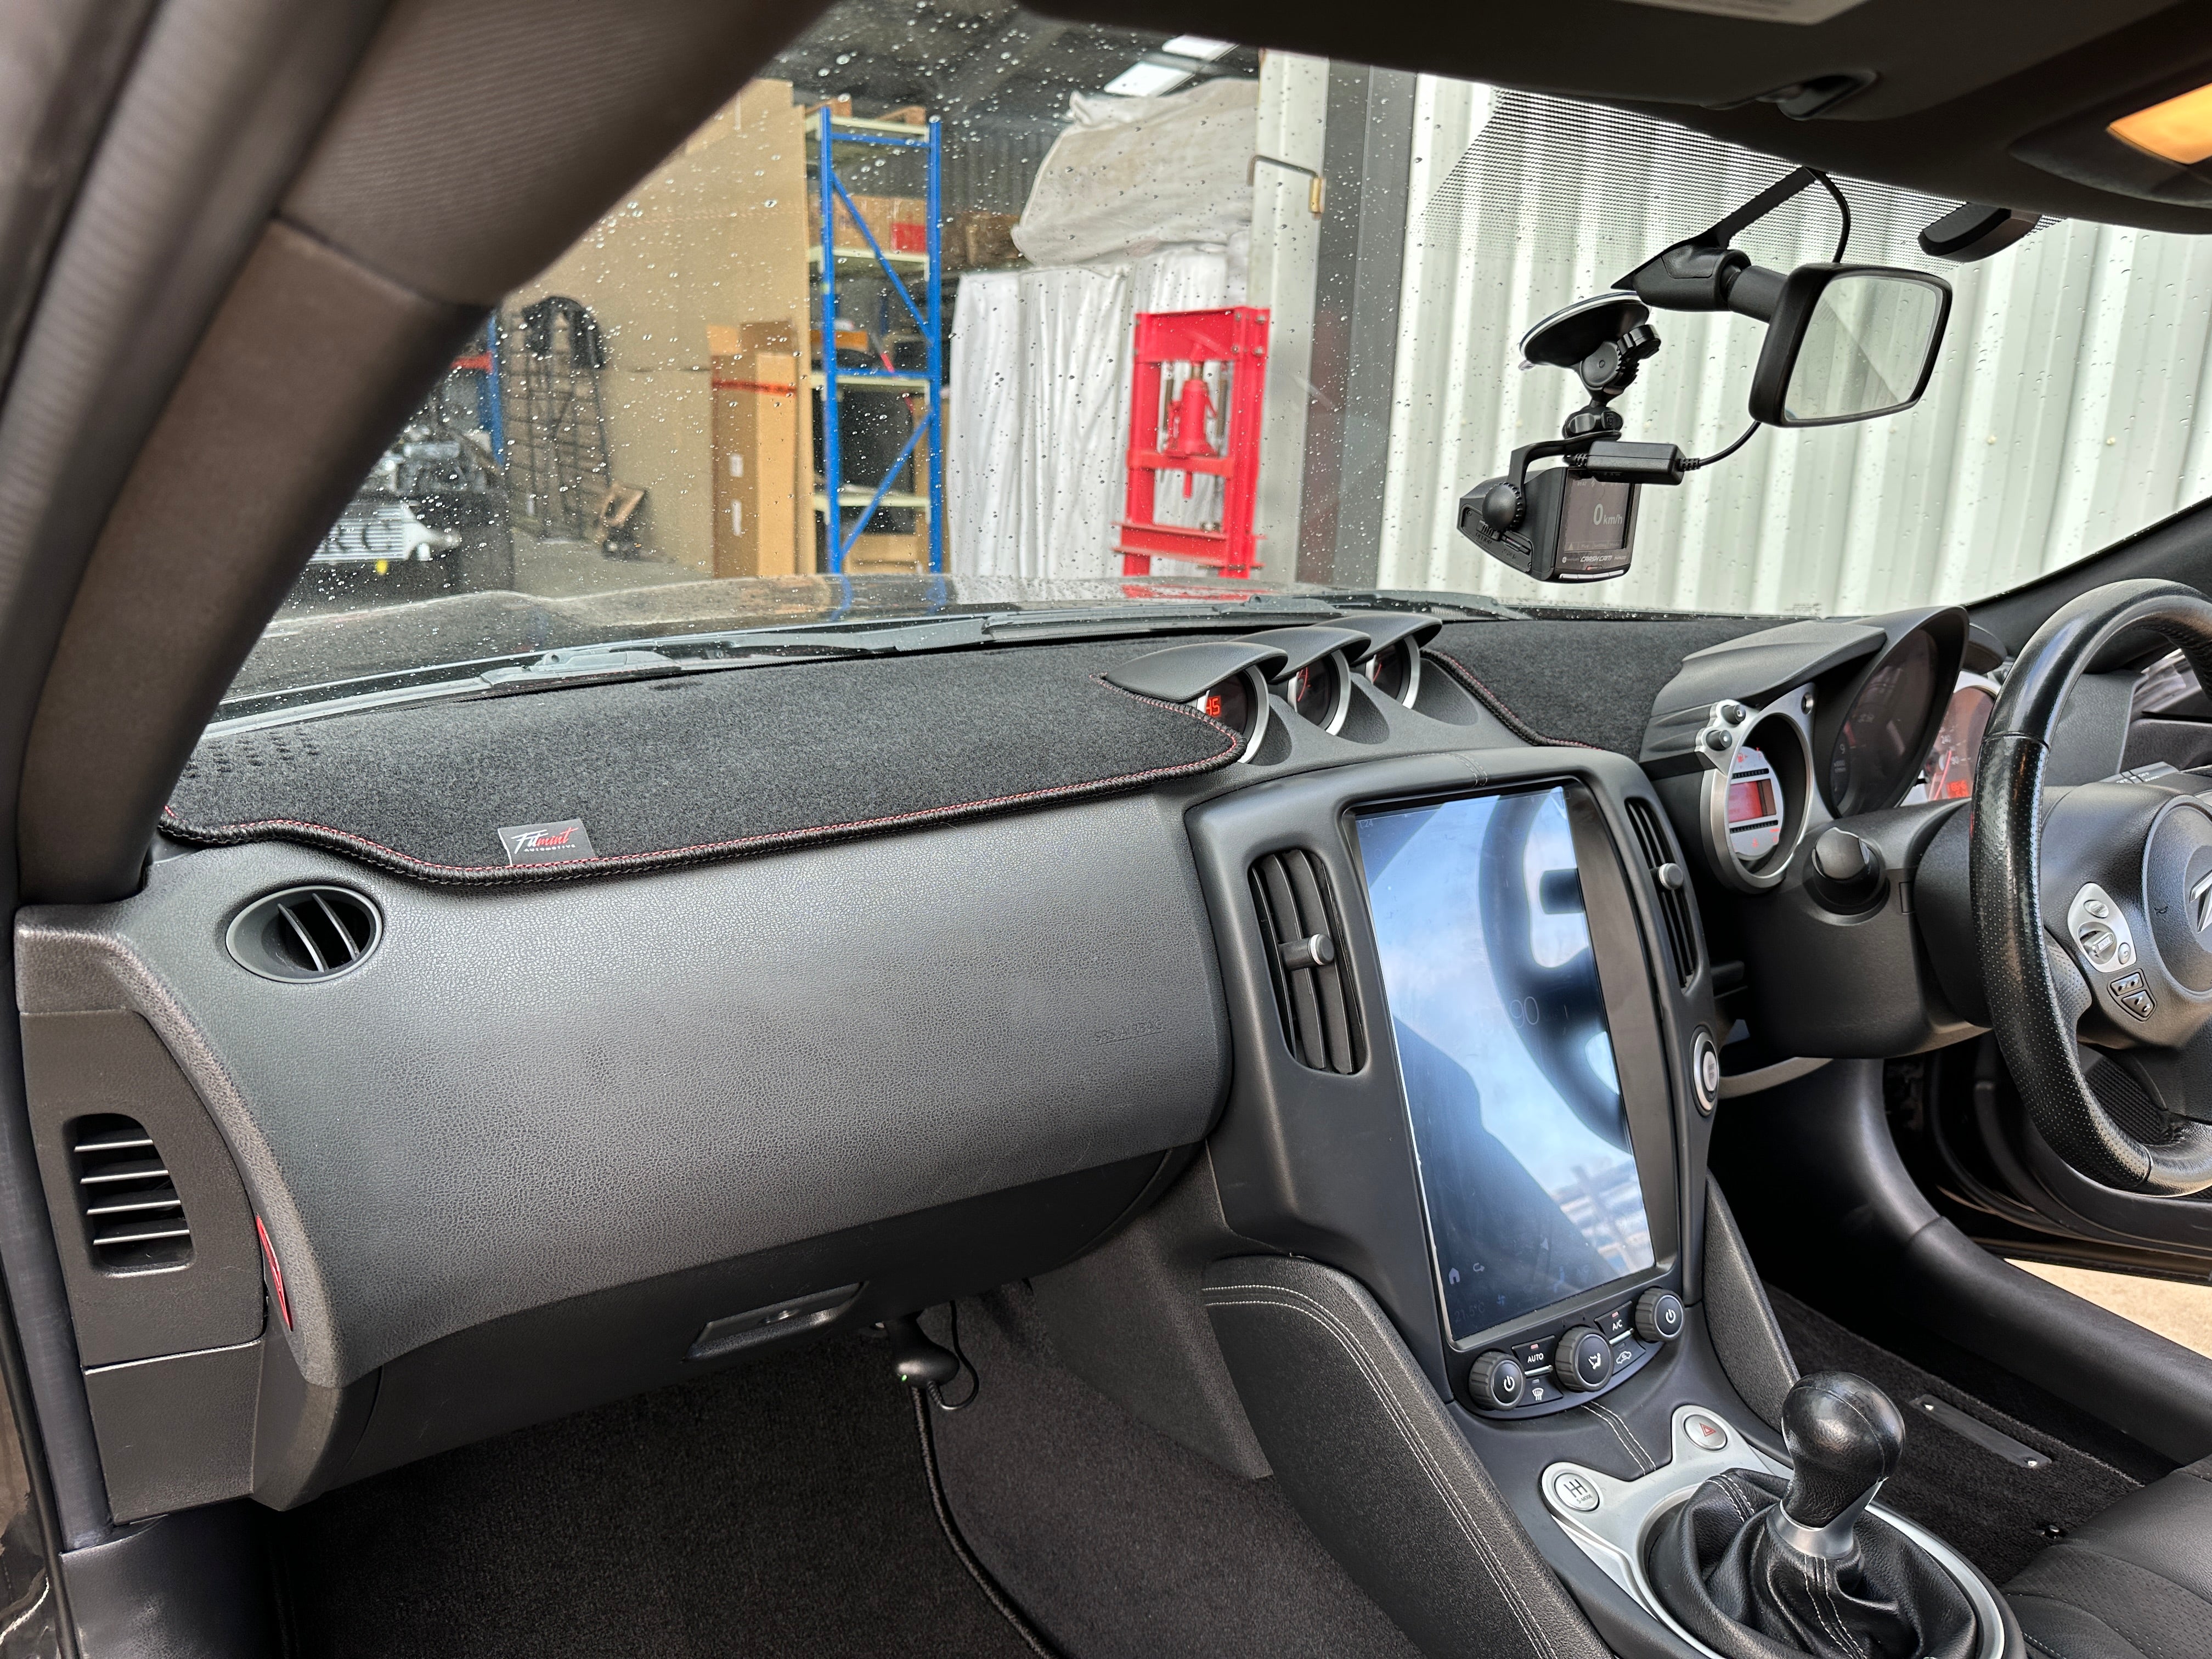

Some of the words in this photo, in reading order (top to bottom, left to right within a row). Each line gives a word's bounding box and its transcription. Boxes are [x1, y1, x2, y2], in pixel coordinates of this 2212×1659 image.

[1593, 504, 1603, 525] 0
[1603, 514, 1622, 524] km/h
[1612, 1319, 1623, 1331] A/C
[1527, 1353, 1544, 1363] AUTO
[1576, 1494, 1593, 1504] S-MODE
